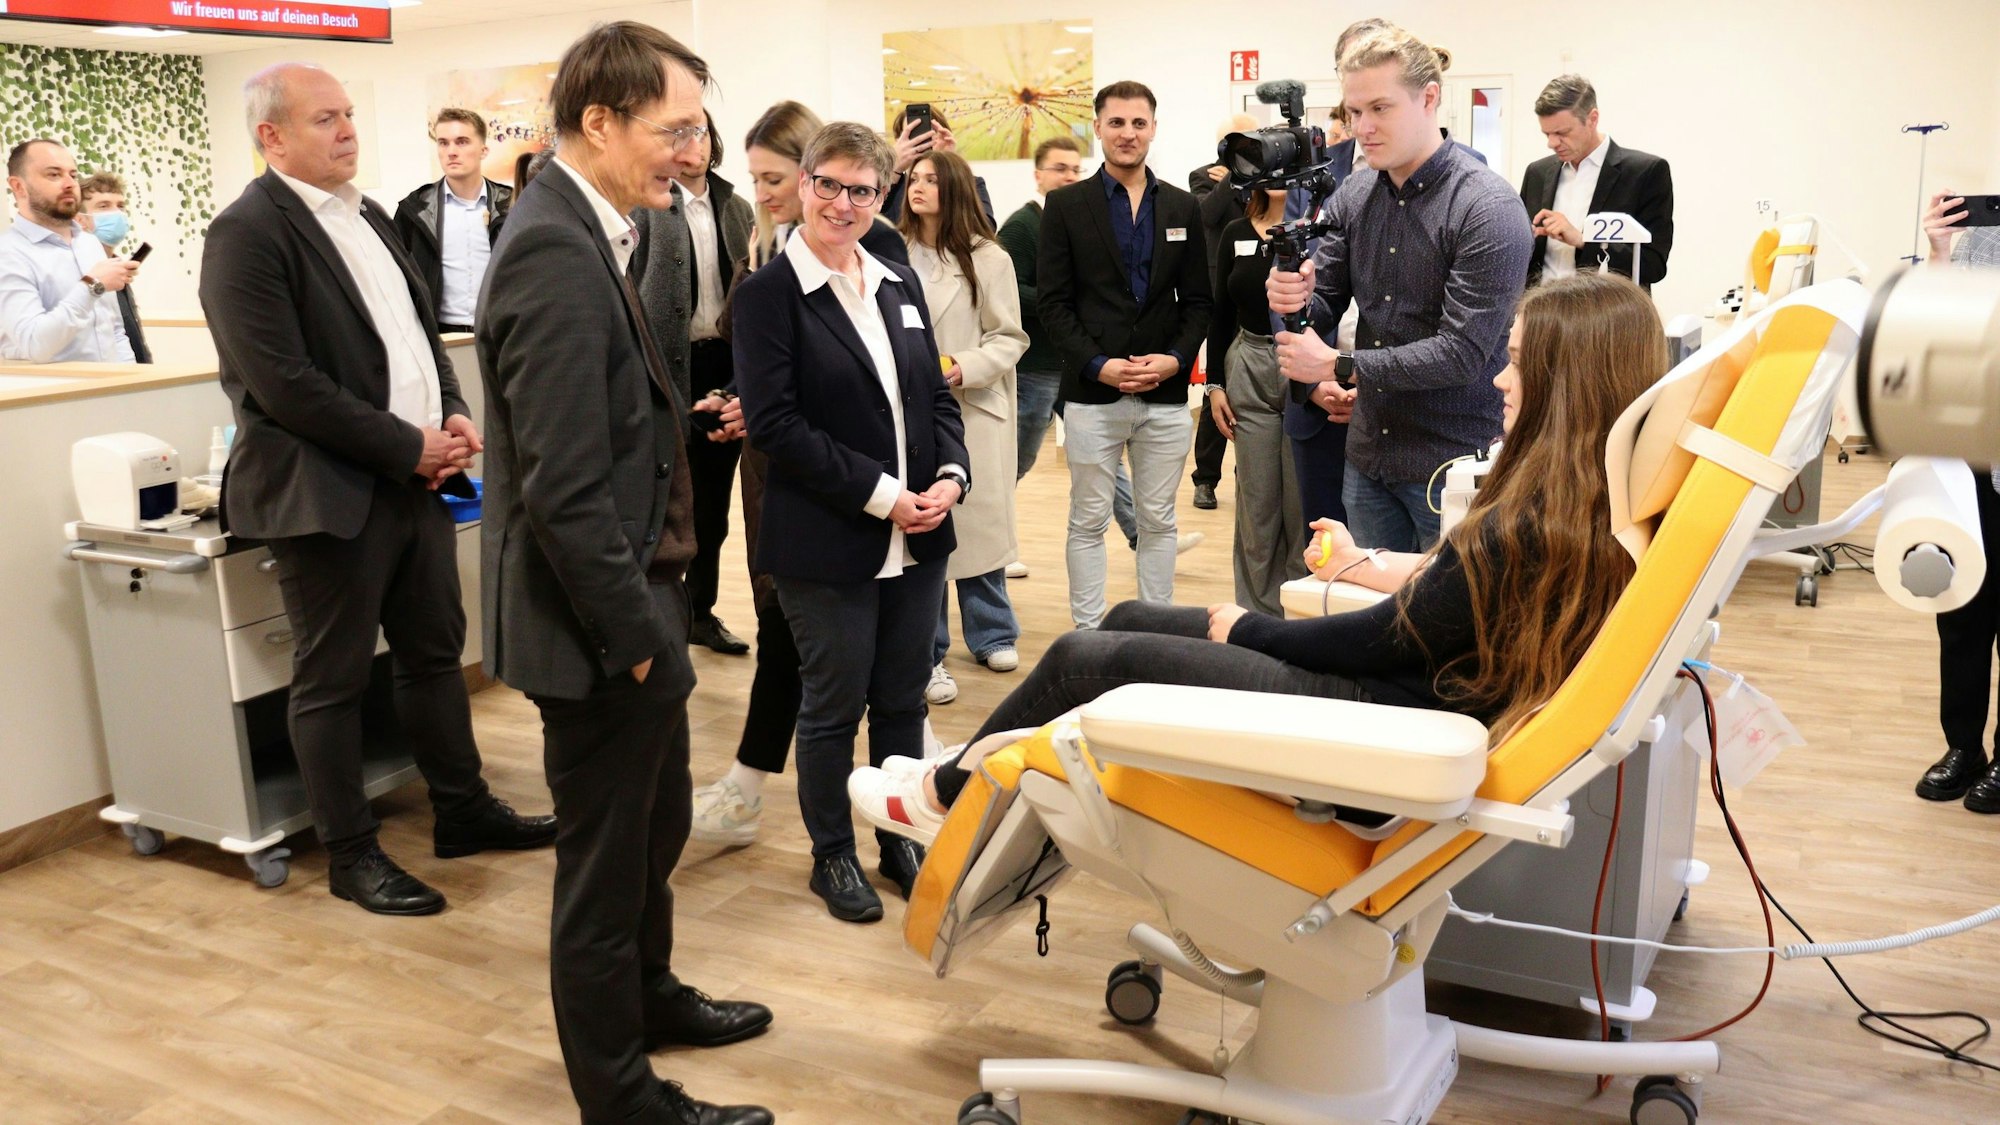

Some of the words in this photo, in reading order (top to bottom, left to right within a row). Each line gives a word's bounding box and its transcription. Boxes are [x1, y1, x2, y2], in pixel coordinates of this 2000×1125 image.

[171, 1, 192, 16] Wir
[196, 4, 235, 19] freuen
[238, 9, 258, 21] uns
[261, 8, 279, 23] auf
[283, 10, 319, 25] deinen
[323, 14, 359, 28] Besuch
[1756, 200, 1770, 211] 15
[1593, 218, 1624, 241] 22
